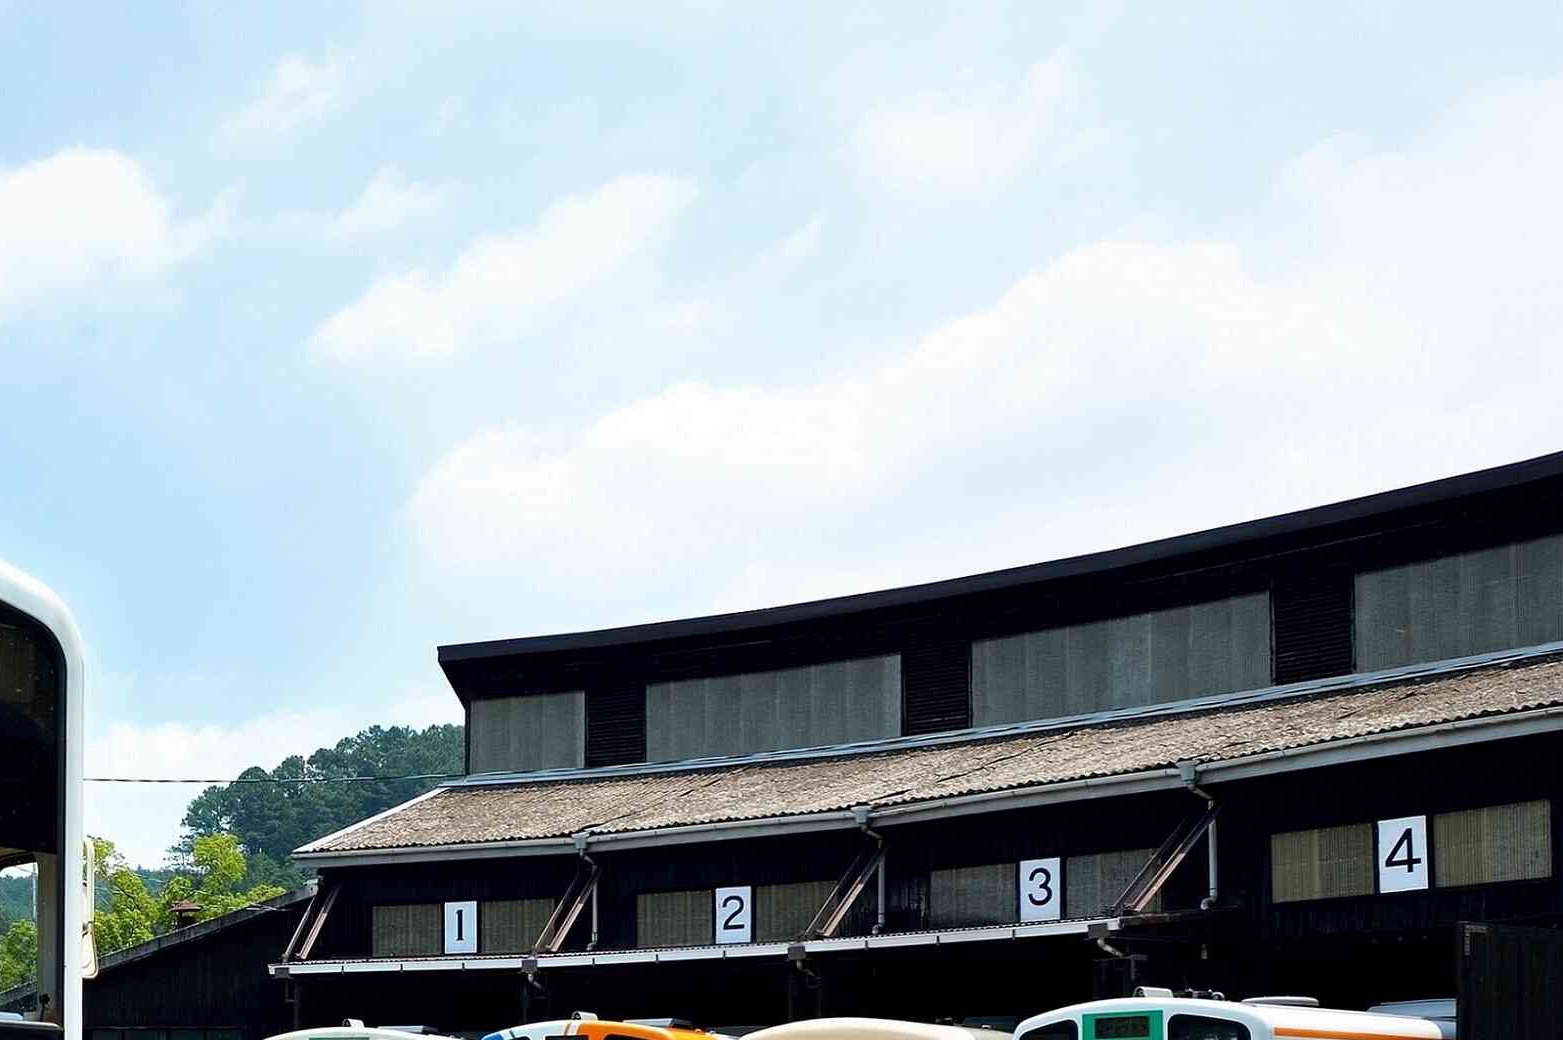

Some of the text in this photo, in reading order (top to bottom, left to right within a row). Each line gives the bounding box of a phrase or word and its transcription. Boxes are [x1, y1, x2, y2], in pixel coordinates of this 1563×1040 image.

[1385, 828, 1421, 873] 4
[1028, 867, 1053, 906] 3
[456, 909, 465, 941] 1
[723, 895, 745, 930] 2
